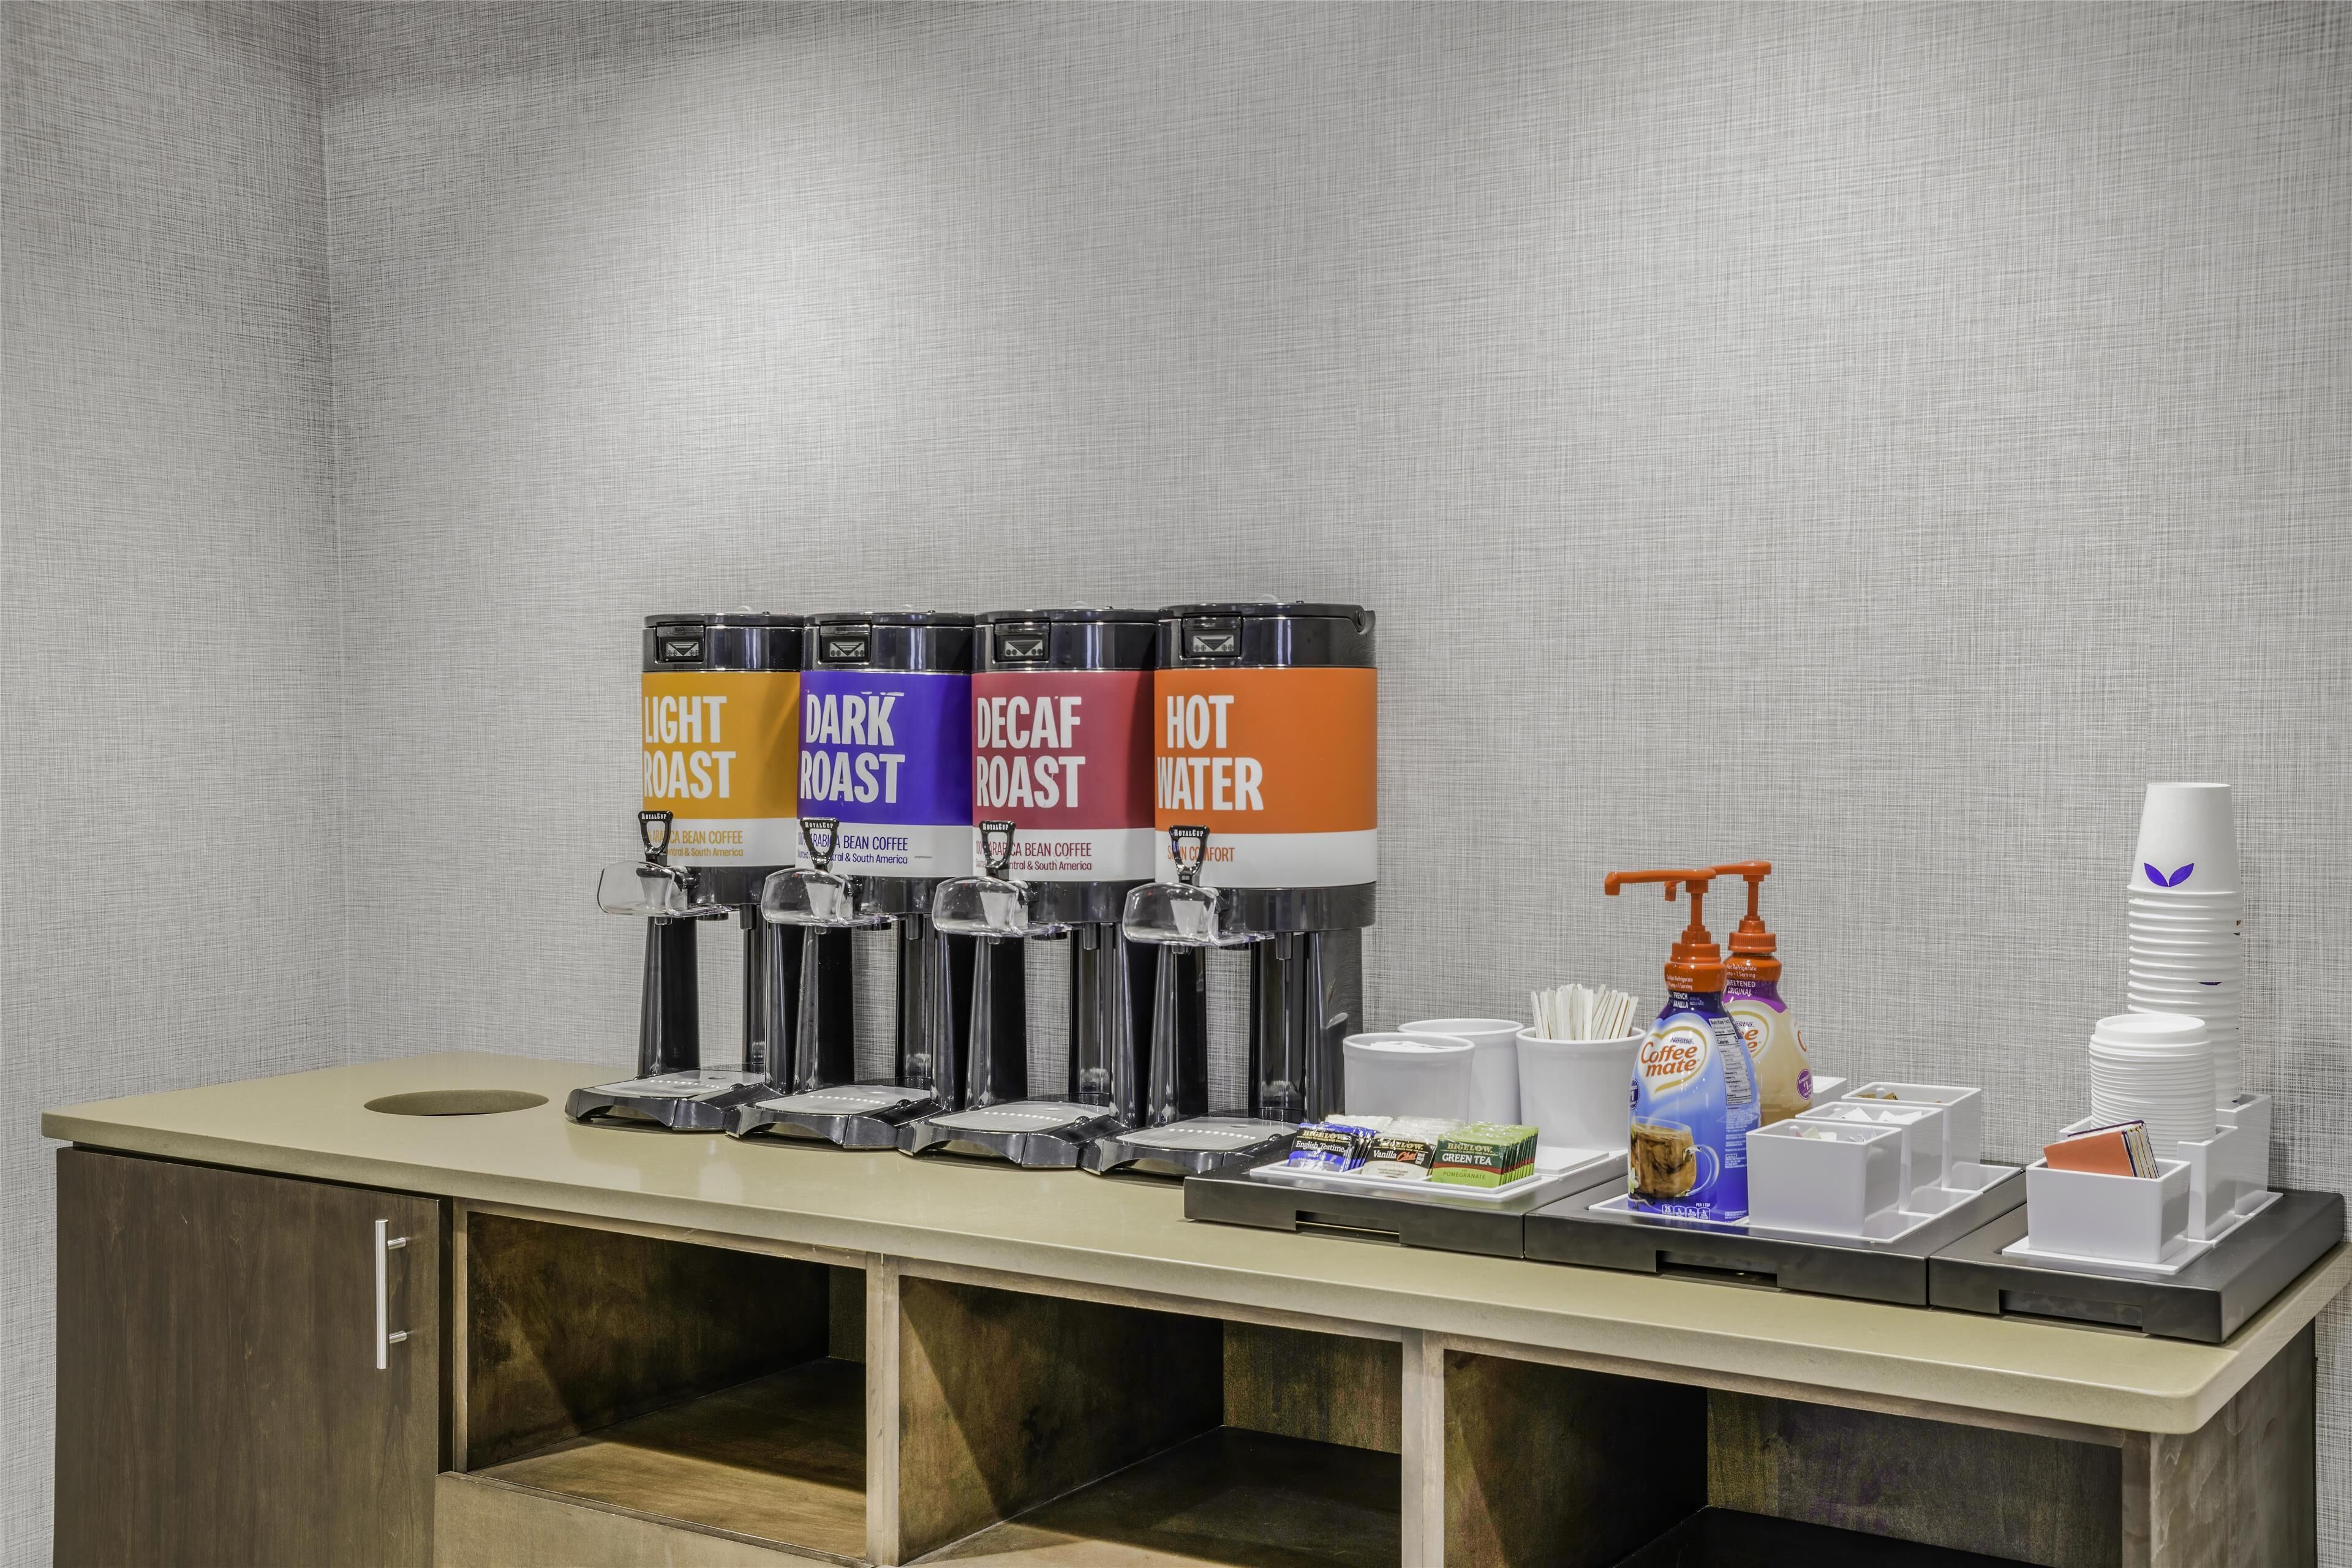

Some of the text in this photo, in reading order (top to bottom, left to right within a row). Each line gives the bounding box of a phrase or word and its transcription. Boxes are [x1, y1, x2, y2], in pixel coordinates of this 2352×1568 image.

[644, 695, 728, 744] LIGHT
[805, 694, 896, 746] DARK
[977, 696, 1082, 749] DECAF
[1167, 694, 1235, 750] HOT
[643, 750, 736, 799] ROAST
[800, 750, 905, 804] ROAST
[976, 755, 1086, 808] ROAST
[1156, 756, 1264, 811] WATER
[682, 830, 706, 844] BEAN
[708, 830, 743, 844] COFFEE
[843, 835, 869, 850] BEAN
[872, 837, 908, 851] COFFEE
[685, 847, 690, 856] &
[691, 847, 711, 856] South
[712, 847, 744, 856] America
[1025, 842, 1051, 856] BEAN
[1055, 842, 1091, 857] COFFEE
[845, 853, 851, 862] &
[852, 853, 874, 863] South
[876, 854, 908, 864] America
[1027, 861, 1033, 870] &
[1035, 860, 1057, 870] South
[1059, 860, 1092, 870] America
[1733, 963, 1757, 972] Refrigerate
[1673, 992, 1688, 1000] FRENCH
[1673, 1000, 1689, 1009] VANILLA
[1641, 1041, 1698, 1064] Coffee
[1645, 1058, 1697, 1077] mate
[1295, 1140, 1319, 1150] English
[1319, 1142, 1345, 1153] Teatime
[1373, 1150, 1397, 1159] Vanilla
[1442, 1153, 1492, 1166] GREEN TEA
[1442, 1170, 1486, 1180] POMEGRANATE
